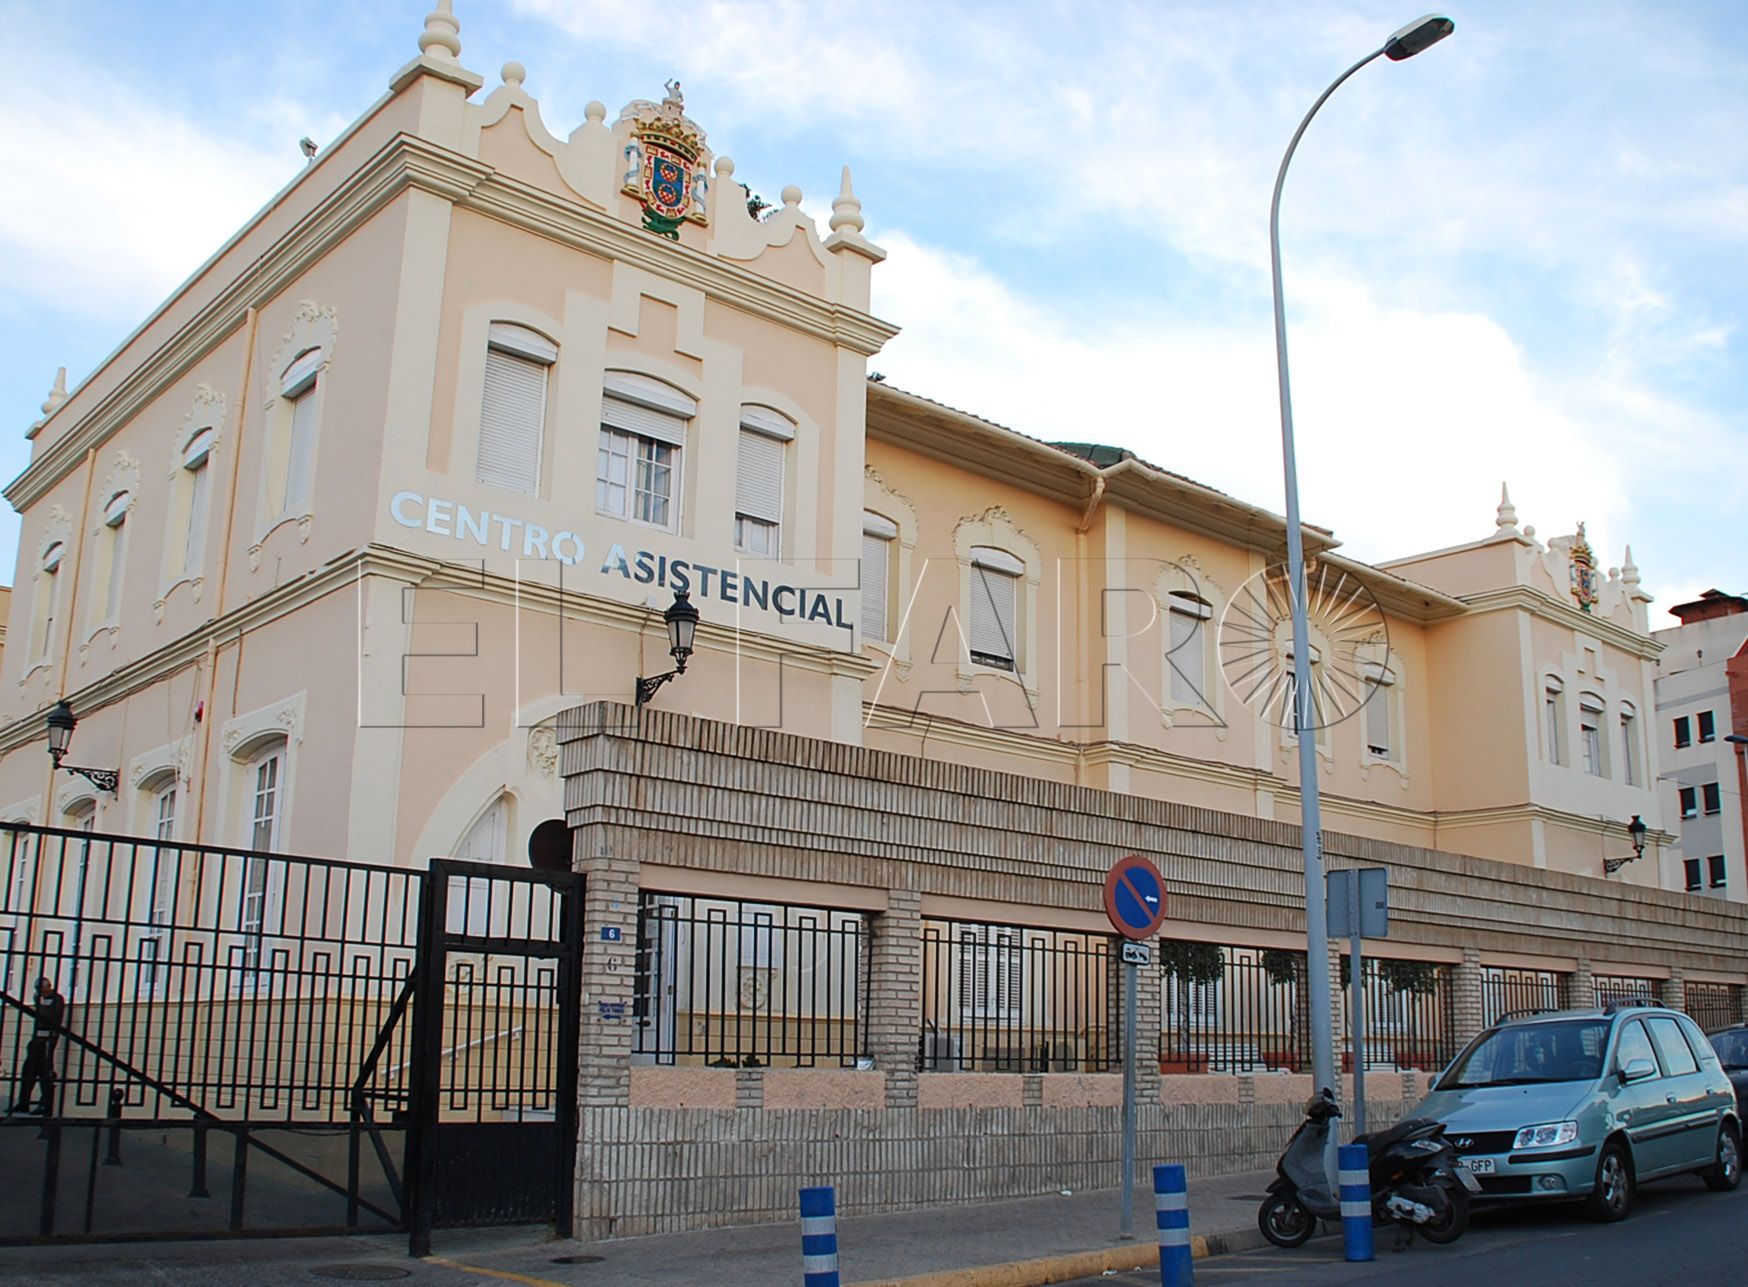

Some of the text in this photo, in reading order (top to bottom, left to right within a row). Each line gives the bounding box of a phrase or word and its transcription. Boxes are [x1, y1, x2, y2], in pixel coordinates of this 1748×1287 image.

[390, 491, 854, 630] CENTRO ASISTENCIAL
[608, 928, 616, 939] 6
[606, 956, 618, 972] 6
[1471, 1159, 1492, 1172] GFP
